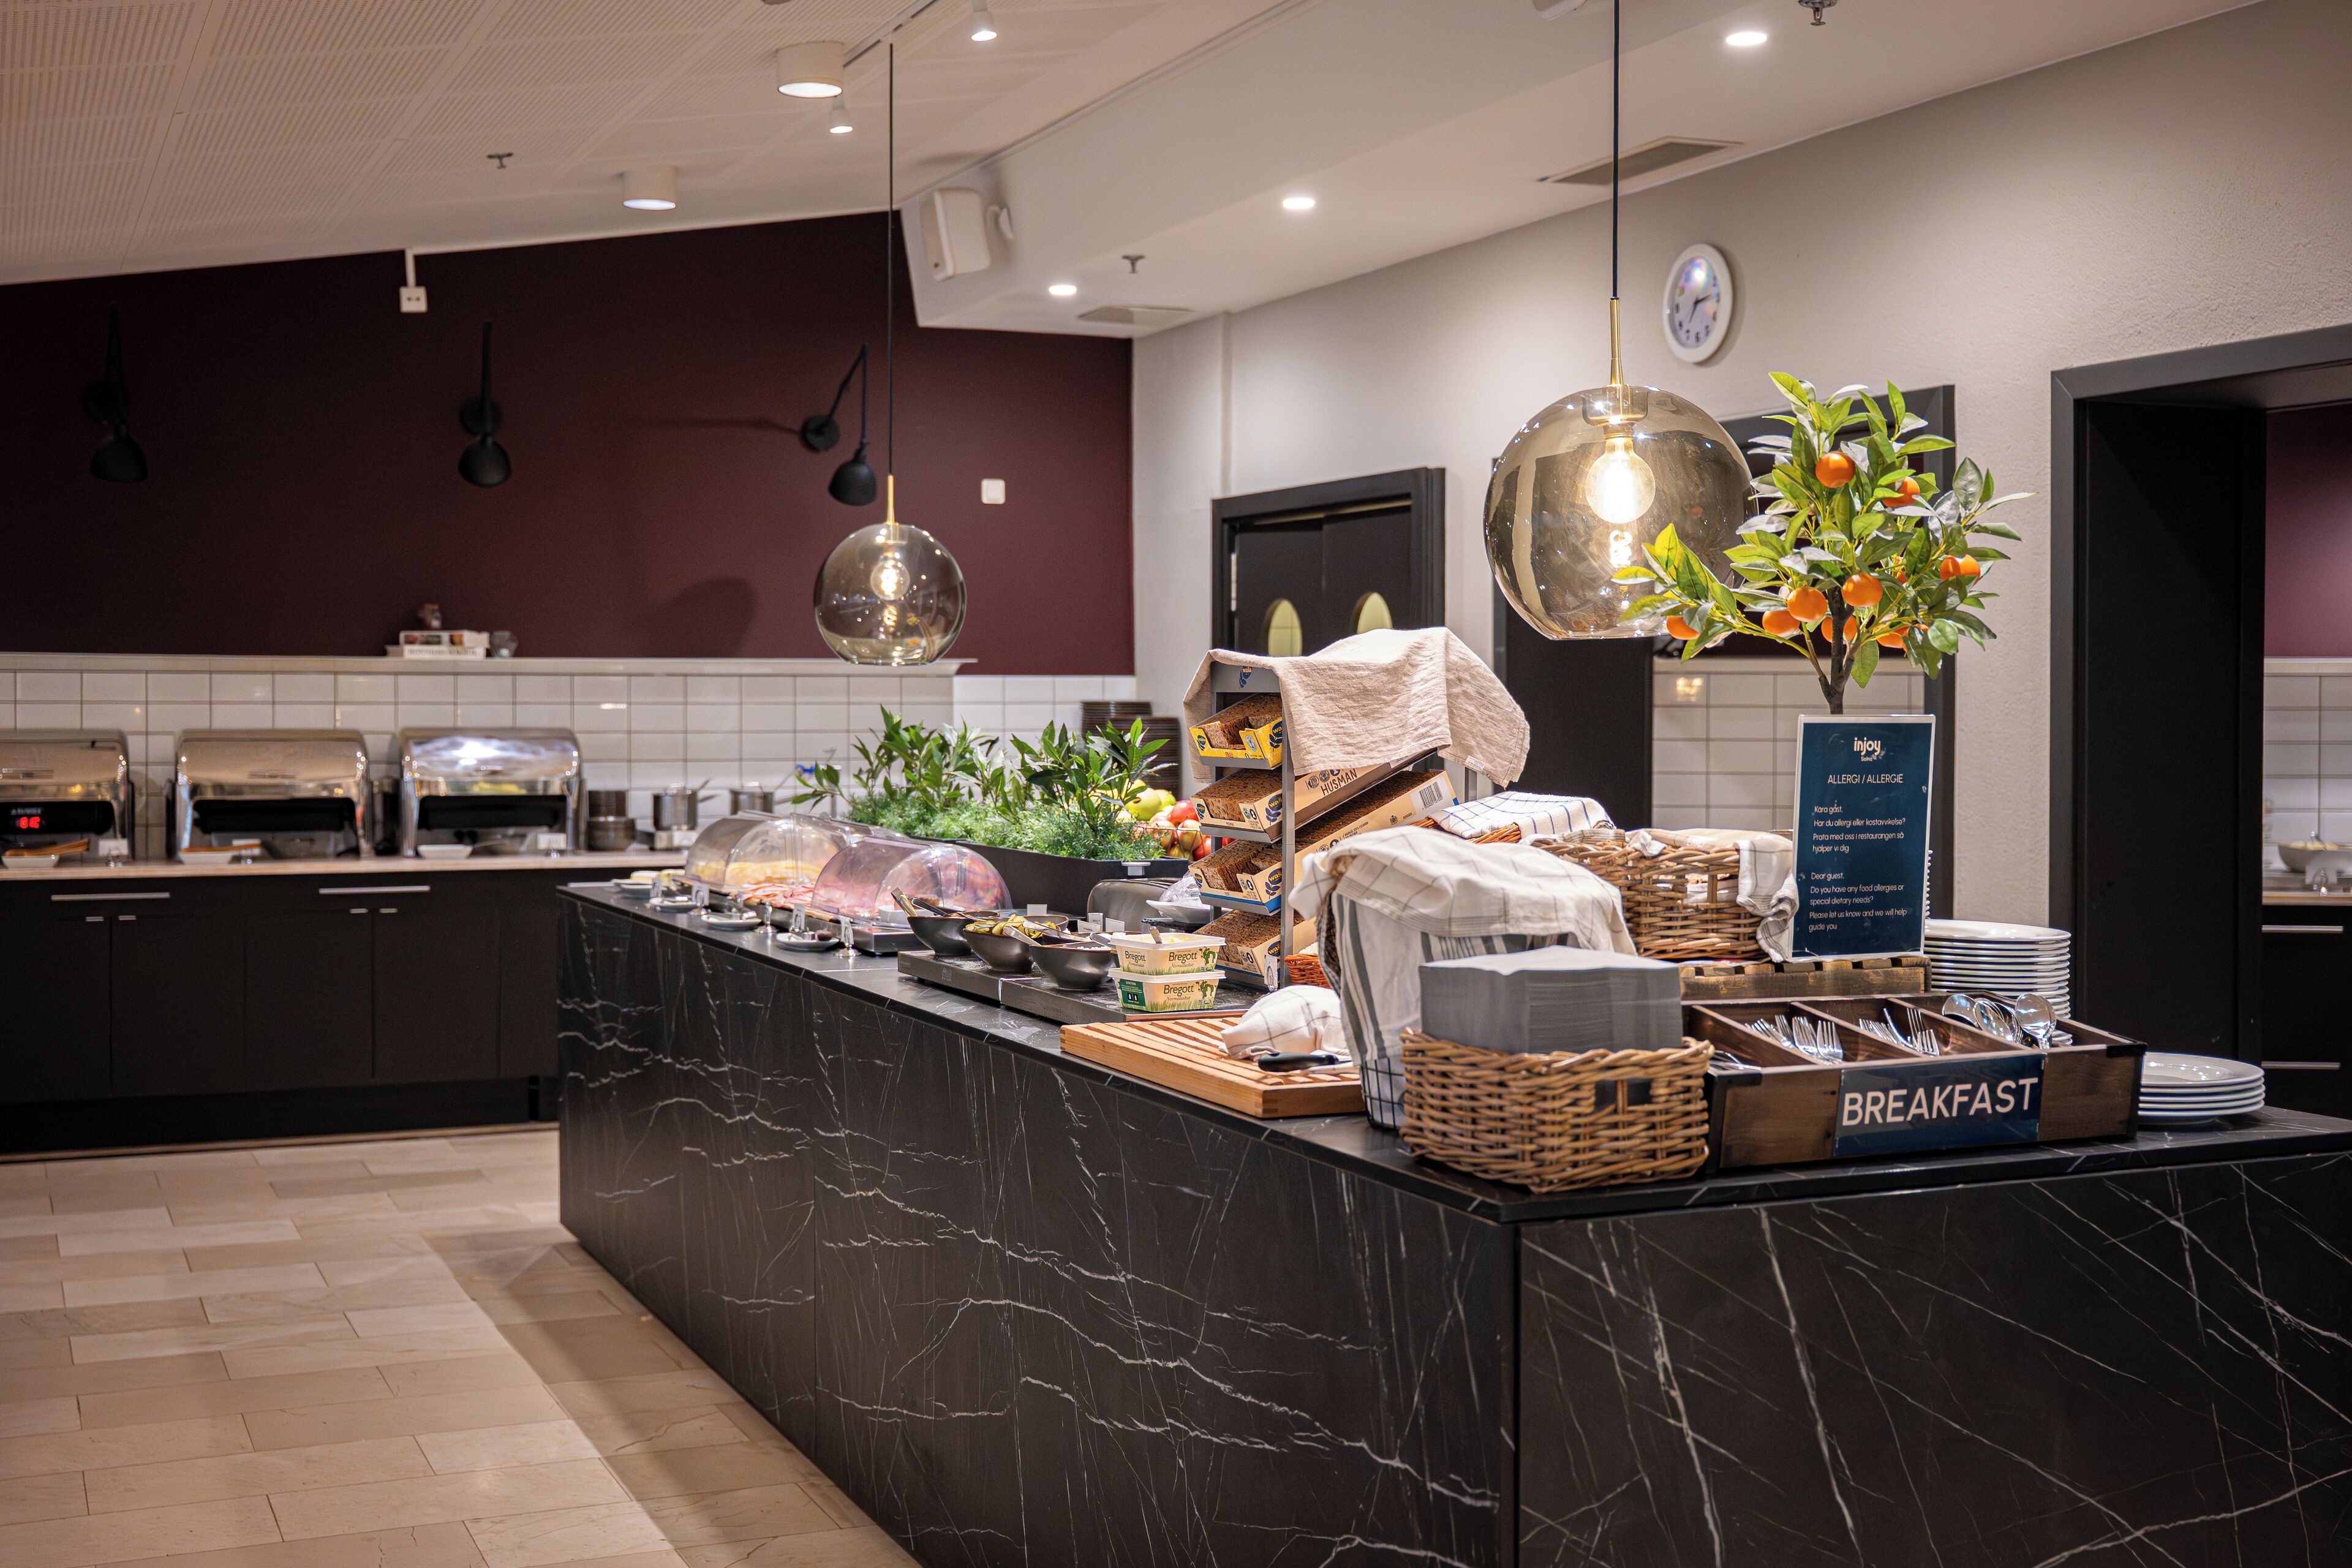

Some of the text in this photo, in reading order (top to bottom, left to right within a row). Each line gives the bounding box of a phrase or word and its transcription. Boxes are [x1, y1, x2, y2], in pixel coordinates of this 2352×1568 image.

[1853, 737, 1881, 756] injoy
[1321, 768, 1358, 796] HUSMAN
[1828, 774, 1903, 784] ALLERGI / ALLERGIE
[1834, 819, 1852, 828] allergi
[1866, 818, 1906, 826] kostavvikelse?
[1858, 832, 1896, 841] restaurangen
[1840, 844, 1849, 853] dig
[1874, 884, 1897, 893] allergies
[1810, 897, 1831, 907] special
[1831, 897, 1852, 906] dietary
[1894, 908, 1907, 918] help
[1809, 922, 1825, 932] guide
[1125, 951, 1146, 963] Bregott
[1169, 951, 1197, 963] Bregott
[1164, 984, 1194, 997] Bregott
[1842, 1077, 2038, 1126] BREAKFAST
